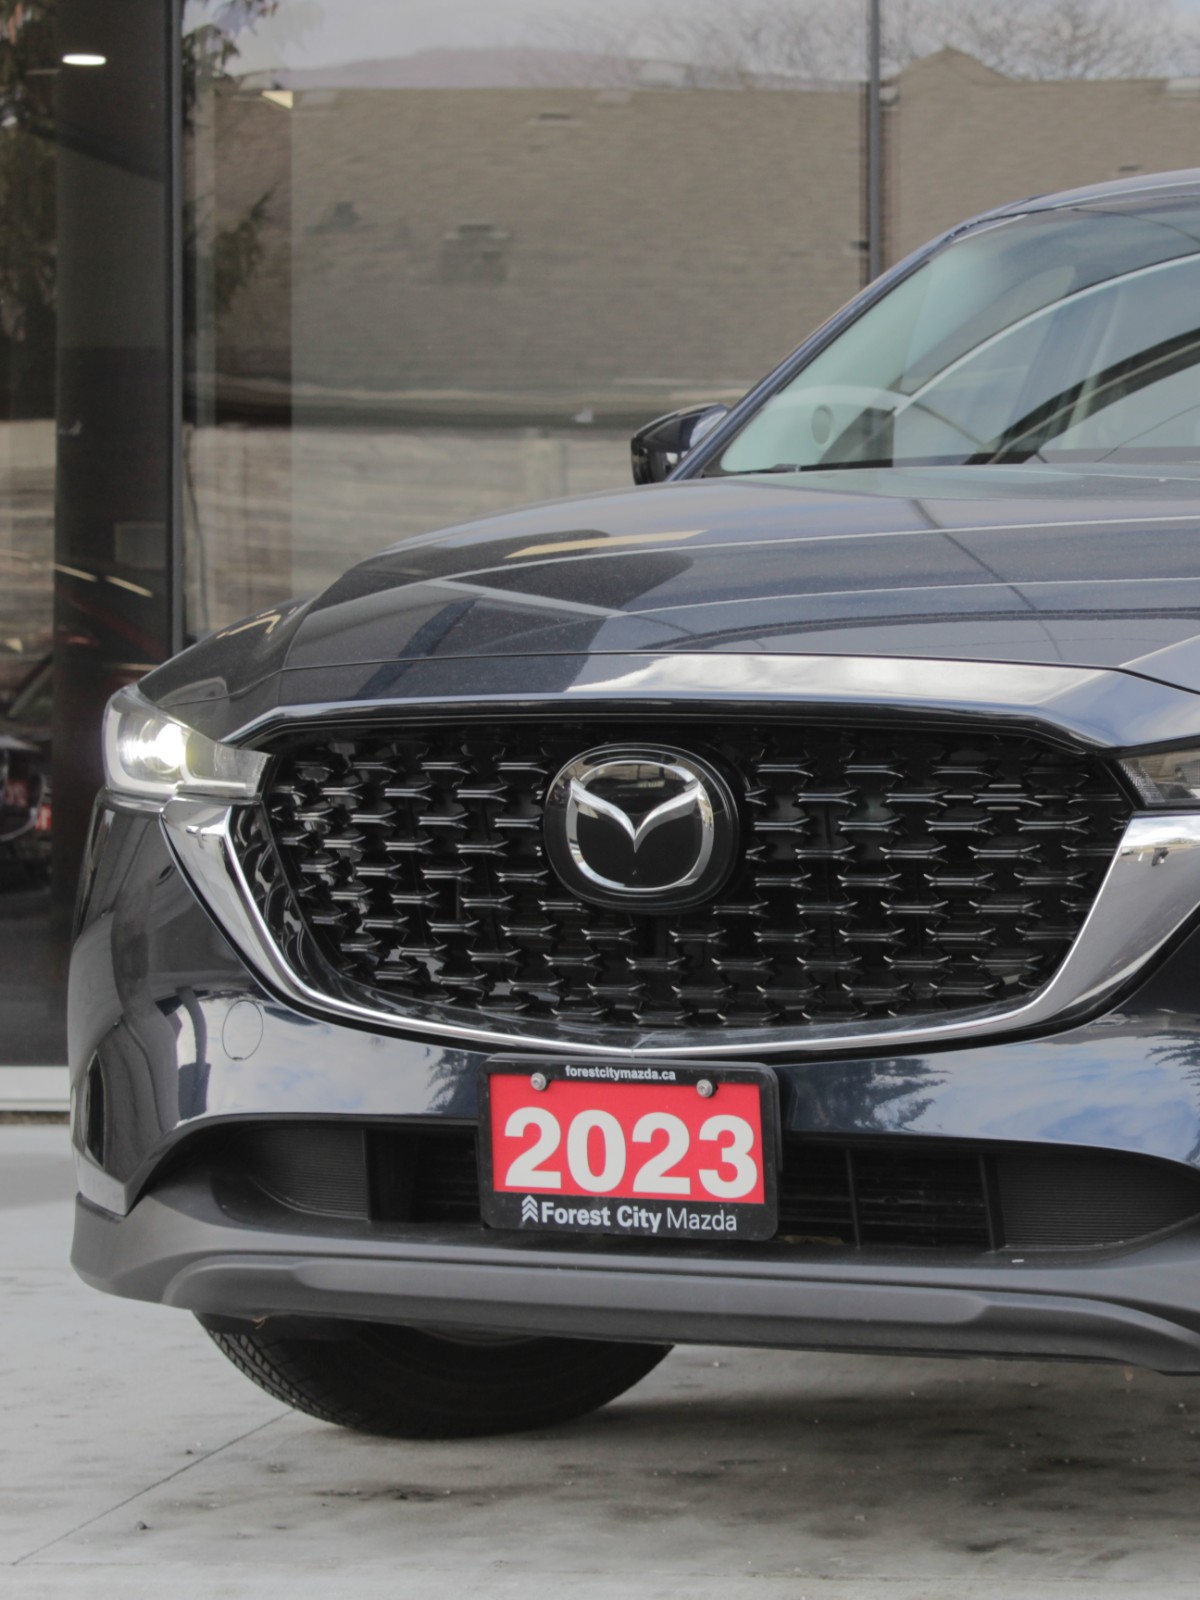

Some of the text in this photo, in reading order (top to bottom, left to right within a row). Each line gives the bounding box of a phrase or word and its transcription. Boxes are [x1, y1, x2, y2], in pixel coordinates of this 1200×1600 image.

[565, 1065, 677, 1081] forestcitymazda.ca
[504, 1106, 758, 1199] 2023
[541, 1201, 738, 1233] Forest City Mazda
